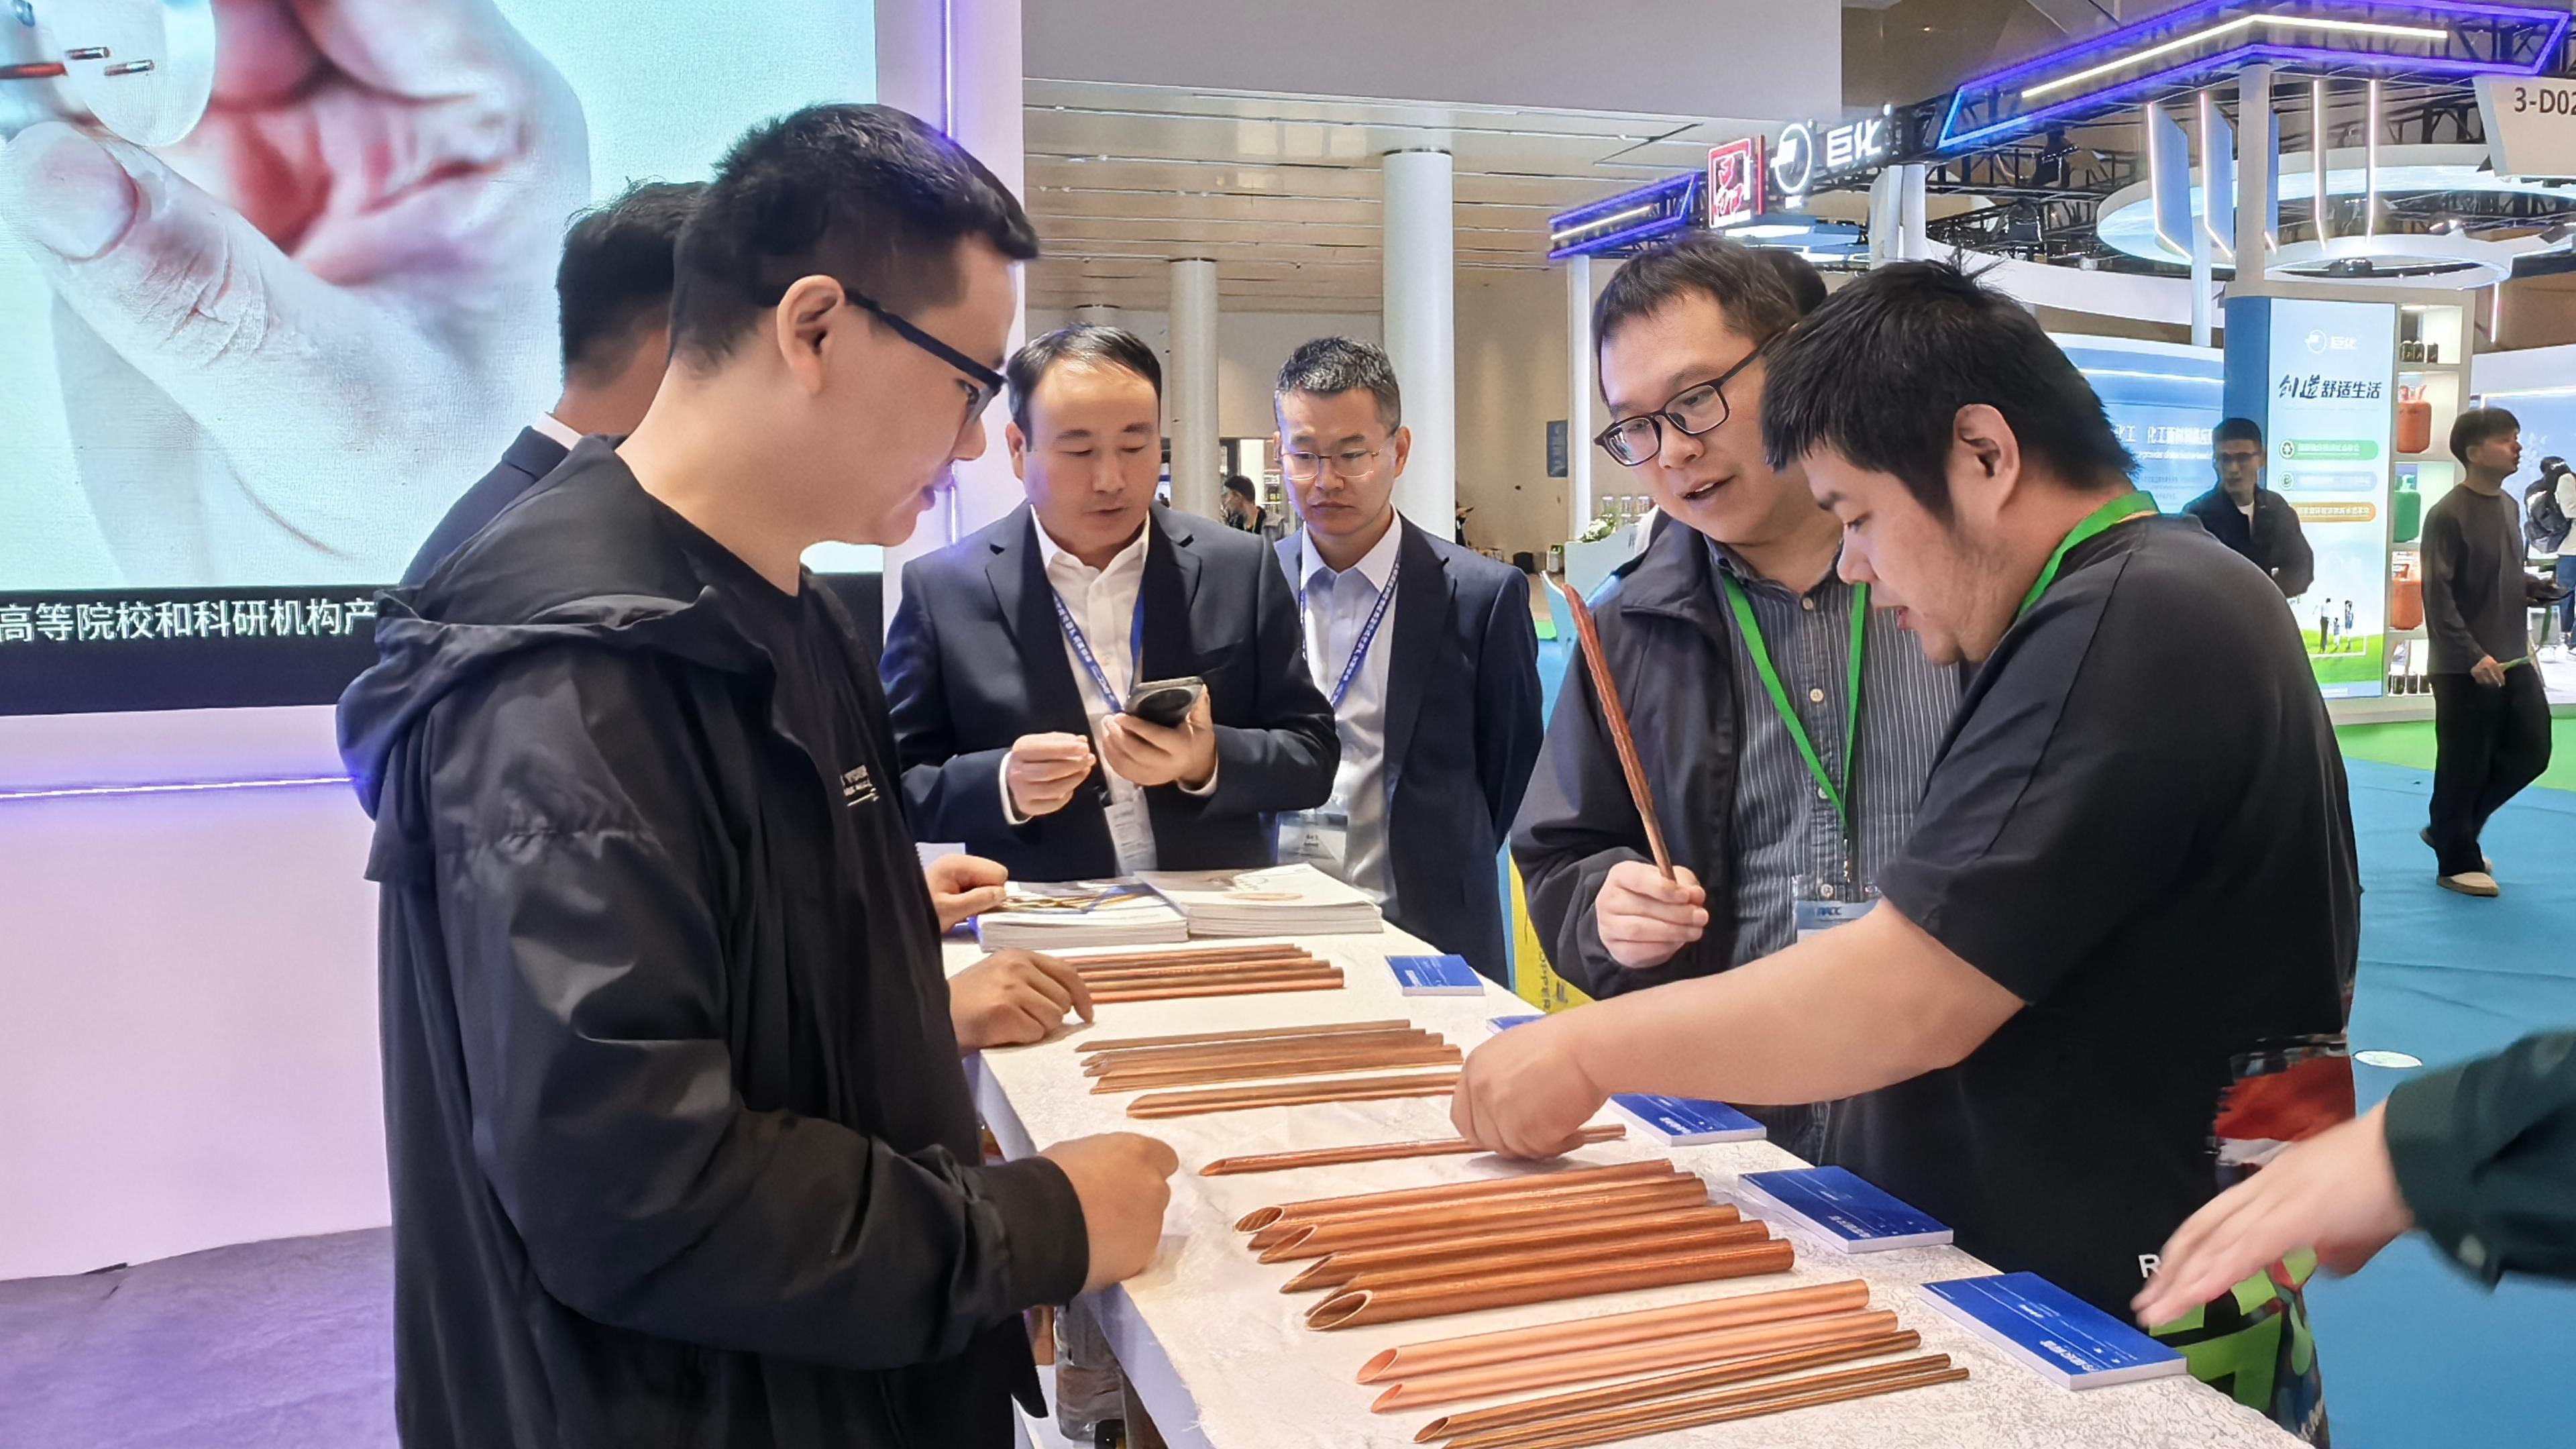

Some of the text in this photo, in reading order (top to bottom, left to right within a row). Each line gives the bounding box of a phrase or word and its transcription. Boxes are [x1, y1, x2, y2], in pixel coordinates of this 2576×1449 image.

[1827, 119, 1882, 167] 巨化
[2330, 335, 2359, 350] 巨化
[2279, 374, 2382, 399] 创造舒适生活
[0, 597, 376, 643] 高等院校和科研机构产
